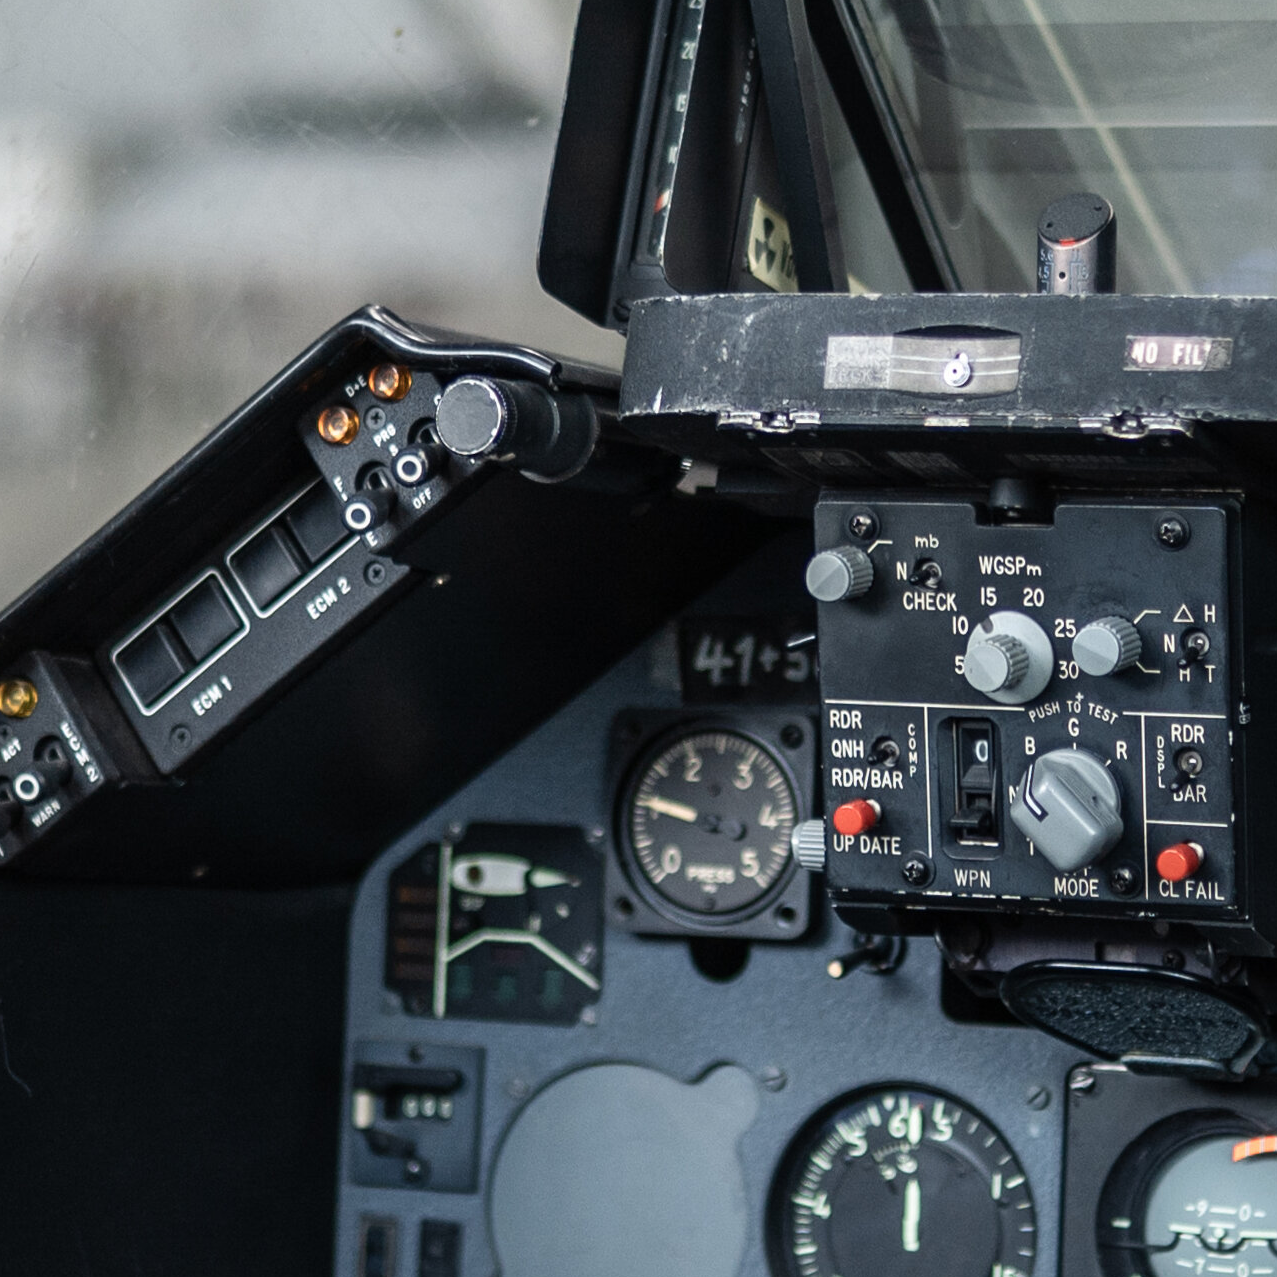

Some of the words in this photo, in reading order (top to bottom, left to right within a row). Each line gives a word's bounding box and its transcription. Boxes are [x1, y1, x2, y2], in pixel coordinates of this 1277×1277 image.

[1131, 341, 1158, 364] NO
[413, 487, 432, 509] OFF
[915, 534, 939, 549] mb
[896, 562, 907, 580] N
[306, 588, 339, 621] ECM
[336, 577, 351, 594] 2
[903, 592, 957, 612] CHECK
[980, 587, 997, 605] 15
[1023, 589, 1044, 607] 20
[952, 617, 969, 635] 10
[1054, 619, 1076, 637] 25
[1163, 634, 1175, 653] N
[954, 656, 965, 675] 5
[1058, 661, 1079, 679] 30
[191, 687, 222, 717] ECM
[221, 675, 233, 692] 1
[829, 710, 862, 730] RDR
[1029, 701, 1061, 723] PUSH
[1067, 700, 1082, 713] TO
[1088, 702, 1119, 725] TEST
[1068, 718, 1079, 736] G
[1171, 725, 1204, 744] RDR
[0, 739, 22, 763] ACT
[831, 739, 864, 759] QNH
[907, 724, 917, 778] COMP
[1024, 737, 1035, 755] B
[1116, 741, 1127, 759] R
[685, 759, 701, 782] 2
[1156, 736, 1165, 789] DSPL
[831, 769, 903, 790] RDR/BAR
[1173, 784, 1206, 803] BAR
[32, 800, 61, 827] WARN
[833, 834, 855, 852] UP
[860, 836, 901, 855] DATE
[661, 846, 681, 873] 0
[740, 846, 760, 877] 5
[954, 869, 990, 888] WPN
[1054, 877, 1099, 898] MODE
[1159, 879, 1179, 898] CL
[1185, 881, 1224, 900] FAIL
